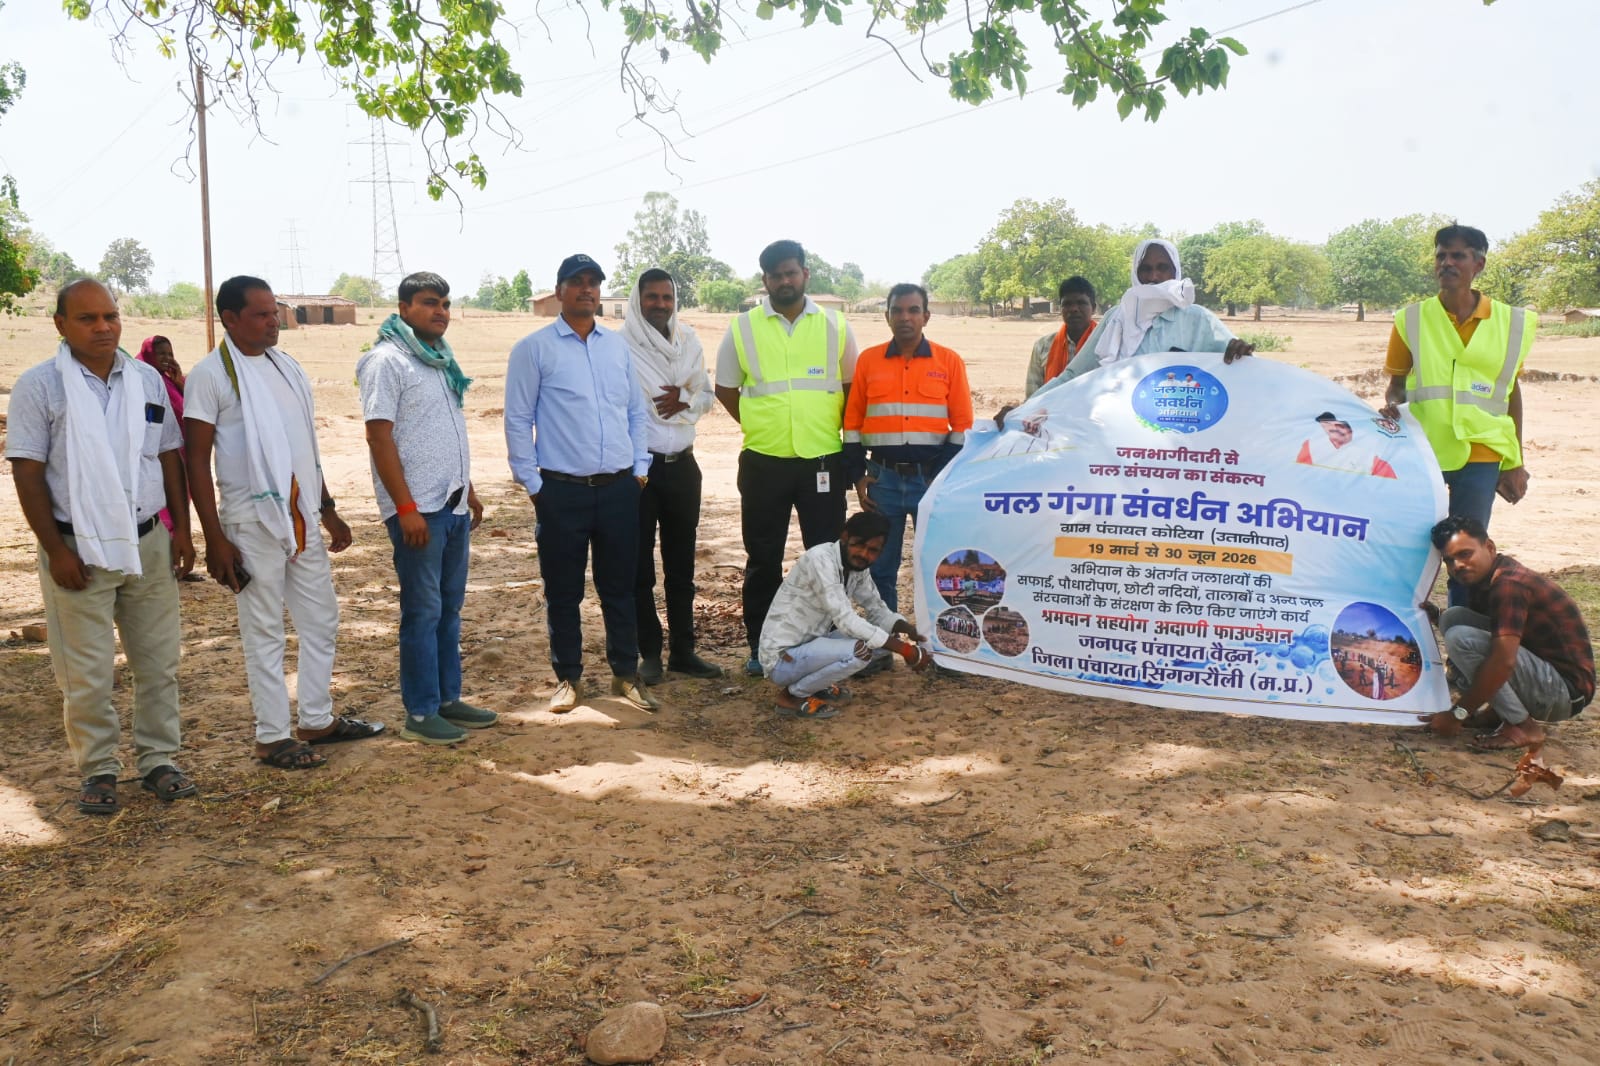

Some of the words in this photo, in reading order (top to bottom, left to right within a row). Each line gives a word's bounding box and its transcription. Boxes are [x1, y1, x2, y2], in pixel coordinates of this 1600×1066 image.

[1116, 446, 1221, 464] जनभागीदारी
[1224, 449, 1239, 465] से
[1089, 464, 1121, 477] जल
[1124, 462, 1180, 480] संचयन
[1183, 469, 1207, 482] का
[1210, 467, 1265, 487] संकल्प
[984, 492, 1043, 515] जल
[1047, 485, 1116, 516] गंगा
[1121, 487, 1229, 524] संवर्धन
[1236, 498, 1370, 541] अभियान
[1060, 523, 1091, 534] ग्राम
[1096, 521, 1147, 537] पंचायत
[1151, 524, 1204, 539] कोटिया
[1211, 527, 1289, 552] (उतानीपाठ)
[1088, 543, 1104, 554] 19
[1109, 541, 1139, 556] मार्च
[1145, 543, 1159, 557] से
[1165, 548, 1182, 559] 30
[1188, 549, 1216, 564] जून
[1221, 552, 1257, 565] 2026
[1070, 561, 1123, 577] अभियान
[1126, 564, 1142, 578] के
[1144, 566, 1188, 581] अंतर्गत
[1192, 571, 1251, 586] जलाशयों
[1253, 574, 1272, 588] की
[1017, 574, 1054, 589] सफाई,
[1058, 576, 1121, 595] पौधारोपण,
[1124, 581, 1155, 596] छोटी
[1157, 583, 1200, 601] नदियों,
[1205, 589, 1252, 603] तालाबों
[1256, 593, 1266, 603] व
[1269, 594, 1297, 605] अन्य
[1300, 597, 1324, 608] जल
[1032, 589, 1091, 607] संरचनाओं
[1093, 594, 1108, 609] के
[1110, 597, 1154, 612] संरक्षण
[1157, 600, 1173, 614] के
[1176, 600, 1204, 615] लिए
[1207, 603, 1237, 618] किए
[1239, 606, 1278, 621] जाएंगे
[1280, 609, 1311, 623] कार्य
[1041, 609, 1092, 627] श्रमदान
[1096, 613, 1149, 633] सहयोग
[1154, 619, 1209, 638] अदाणी
[1213, 624, 1293, 644] फाउण्डेशन
[1079, 634, 1138, 655] जनपद
[1141, 637, 1206, 660] पंचायत
[1031, 646, 1074, 669] जिला
[1078, 654, 1138, 679] पंचायत
[1141, 660, 1245, 689] सिंगगरौली
[1250, 671, 1313, 694] (म.प्र.)
